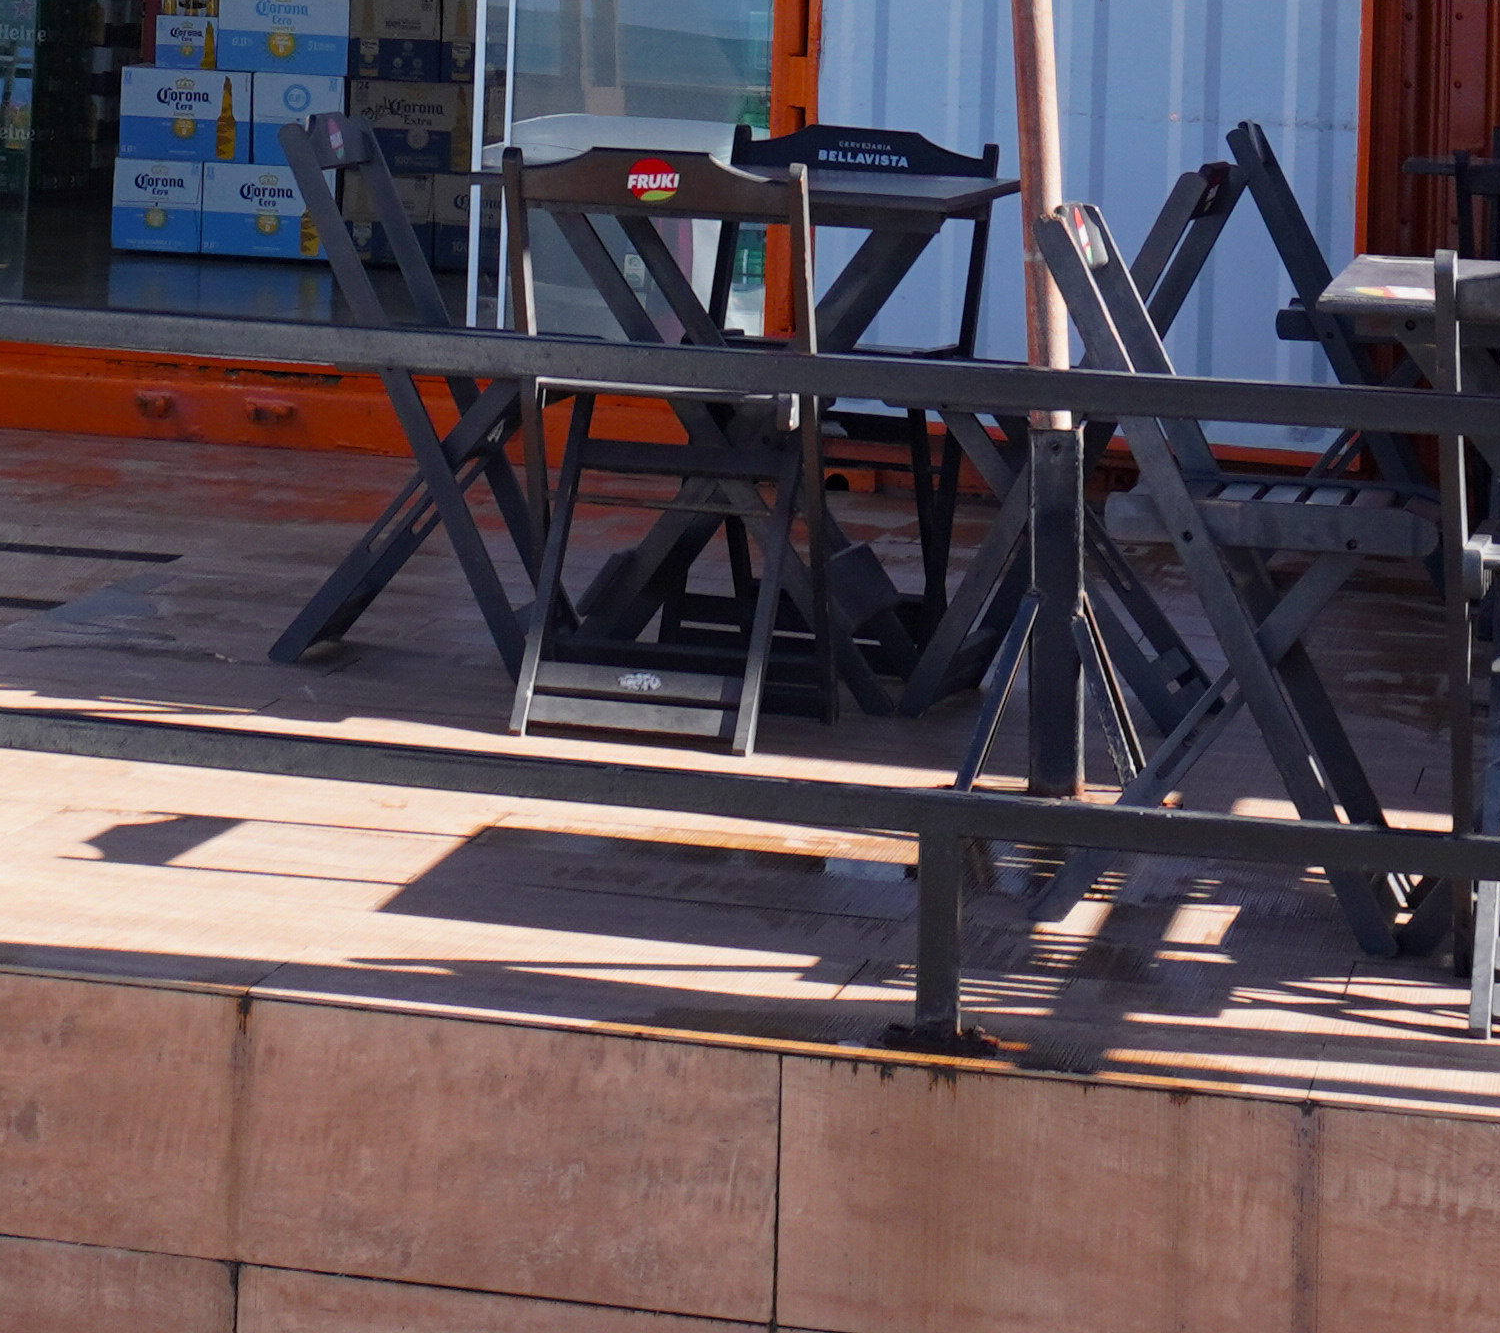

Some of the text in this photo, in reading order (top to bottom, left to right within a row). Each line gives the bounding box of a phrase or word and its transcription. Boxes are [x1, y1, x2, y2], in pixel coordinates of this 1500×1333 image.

[255, 0, 310, 17] Corona
[156, 86, 211, 106] Corona
[839, 140, 892, 151] CERVEJARIA
[818, 149, 909, 168] BELLAVISTA
[134, 172, 185, 191] Corona
[627, 172, 680, 191] FRUKI
[239, 183, 296, 201] Corona
